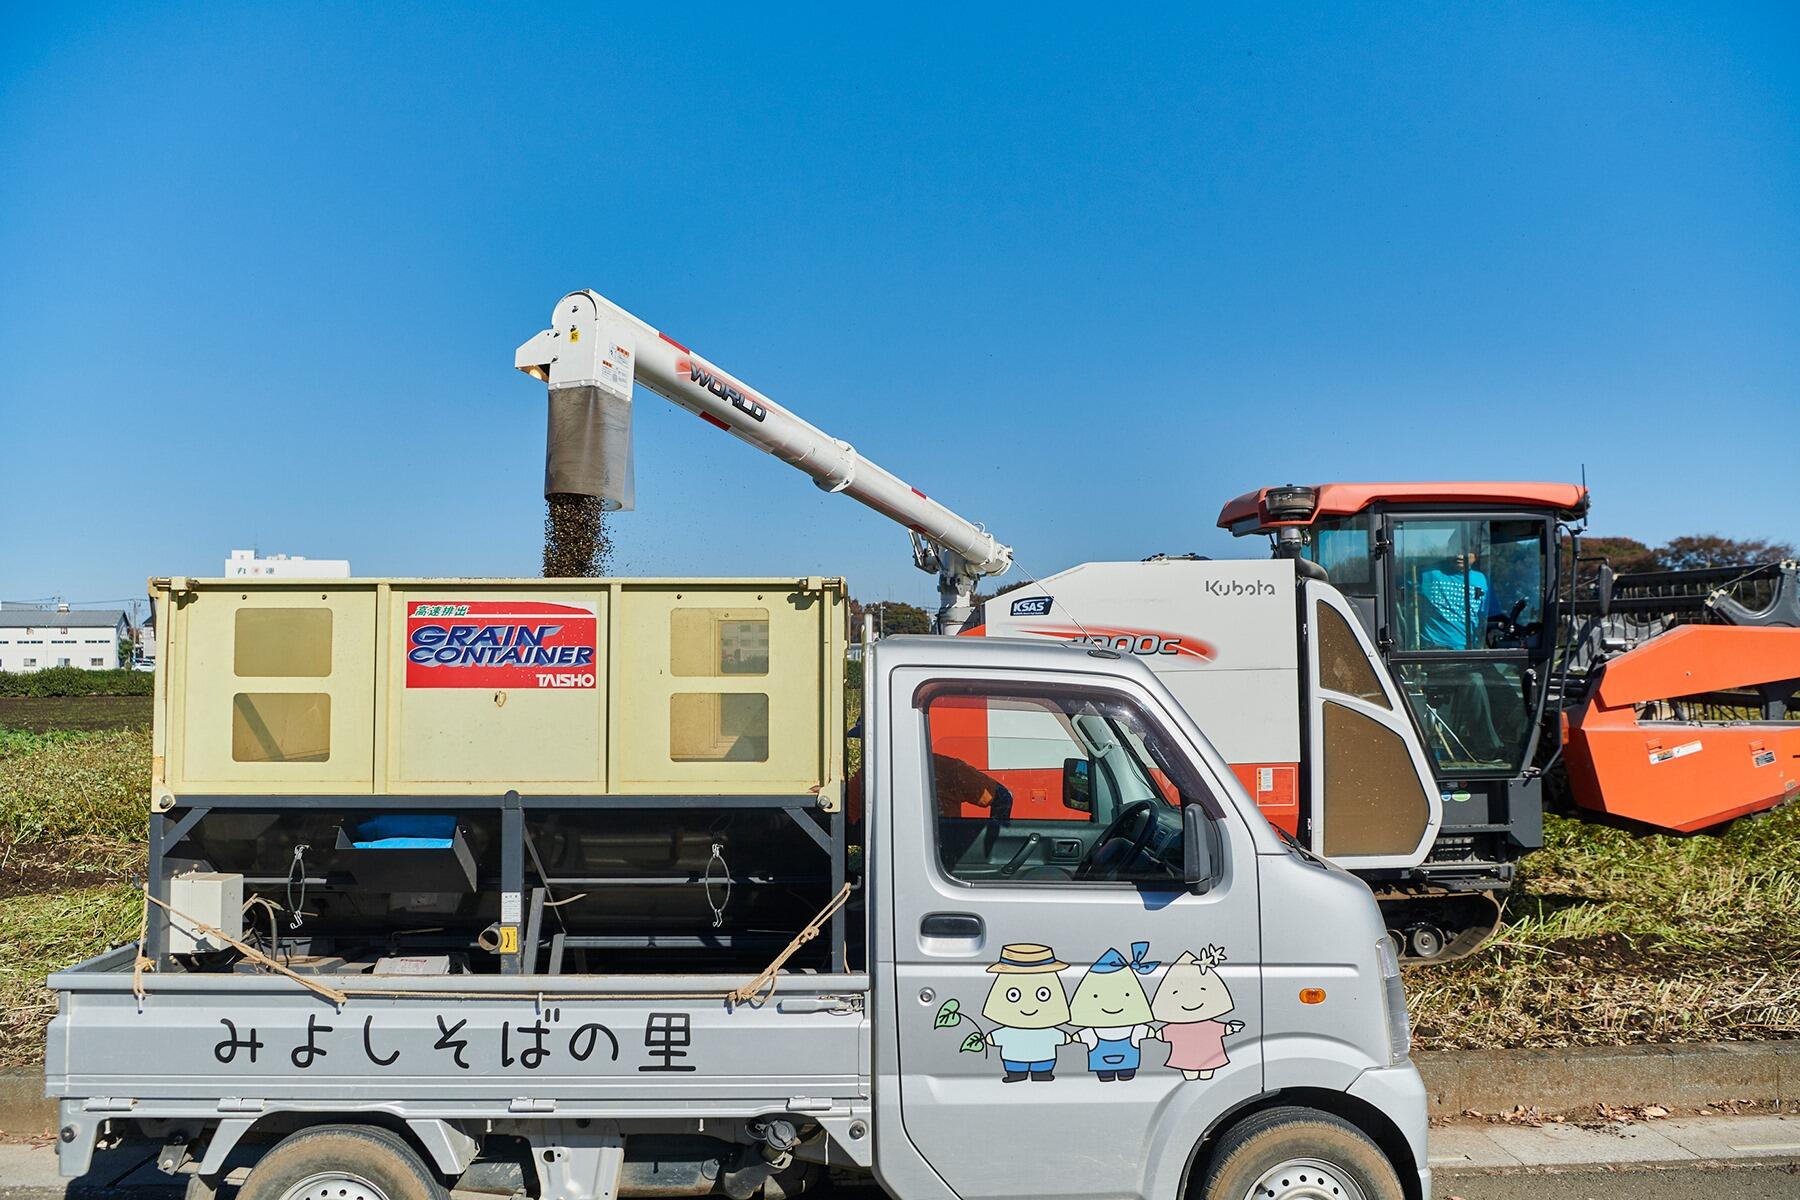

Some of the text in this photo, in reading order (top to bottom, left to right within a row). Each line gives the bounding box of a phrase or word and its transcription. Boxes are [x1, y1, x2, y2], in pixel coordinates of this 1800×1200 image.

[690, 363, 766, 422] WORLD
[1205, 580, 1275, 596] Kubota
[413, 605, 470, 617] 高速排出
[1013, 602, 1045, 612] KSAS
[411, 625, 561, 647] GRAIN
[408, 646, 595, 667] CONTAINER
[537, 674, 594, 687] TAISHO
[214, 1010, 697, 1071] みよしそばの里
